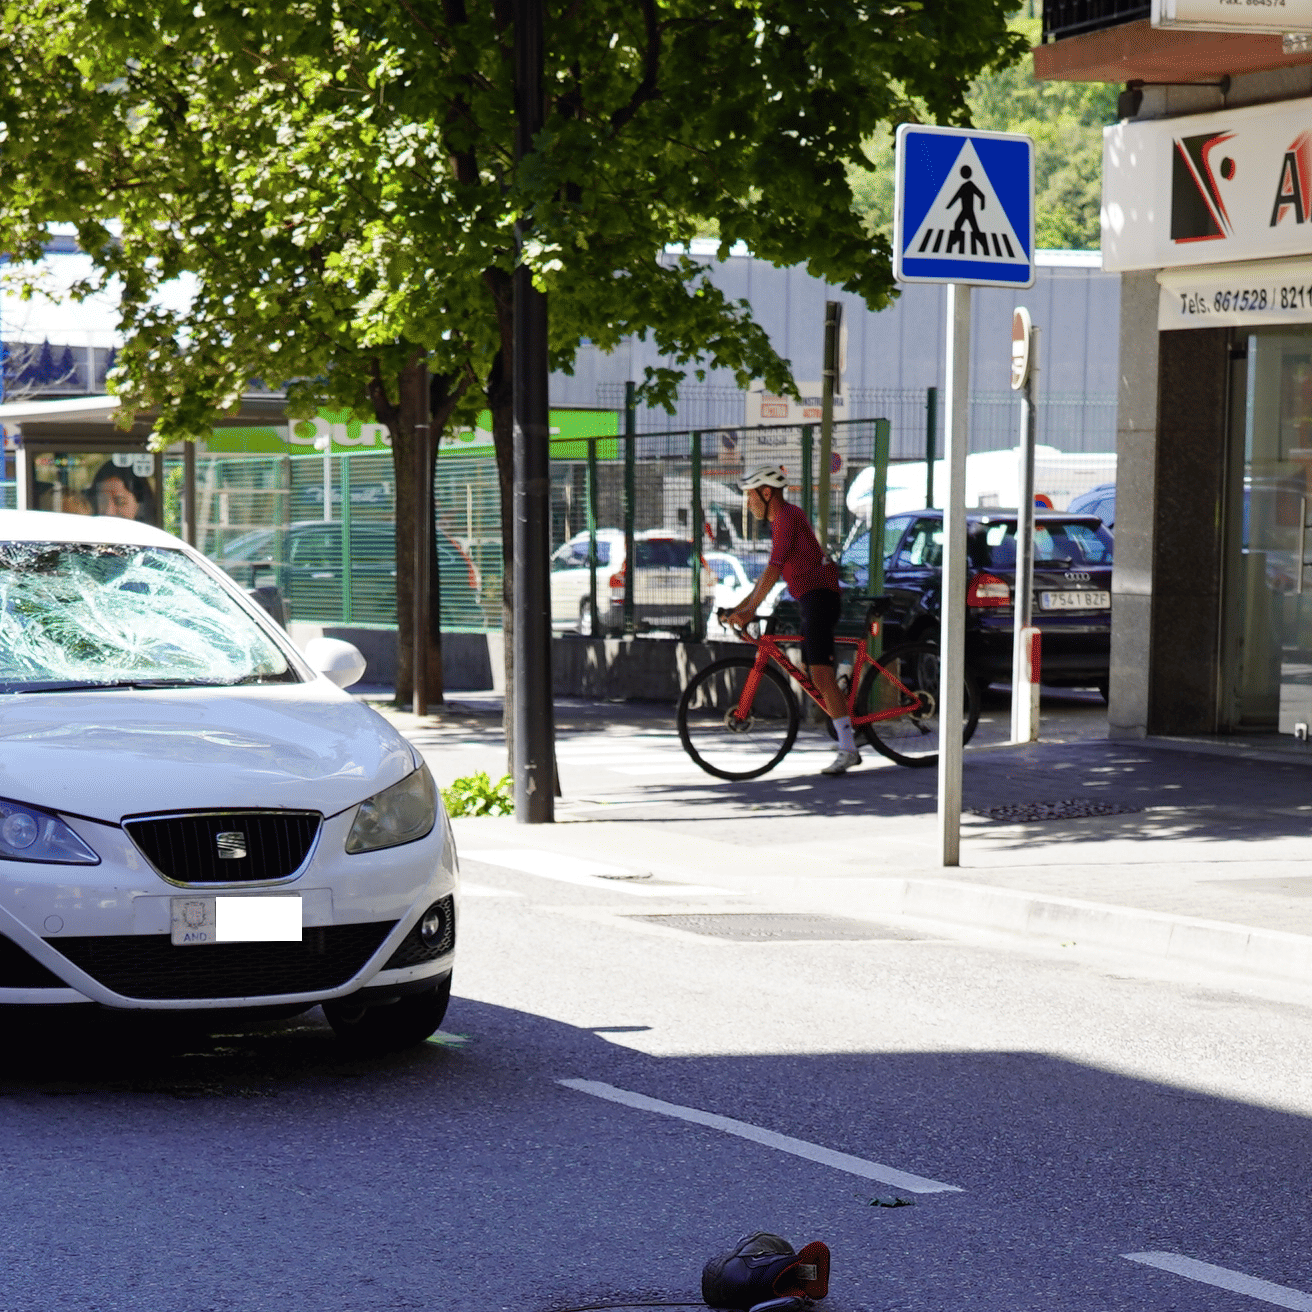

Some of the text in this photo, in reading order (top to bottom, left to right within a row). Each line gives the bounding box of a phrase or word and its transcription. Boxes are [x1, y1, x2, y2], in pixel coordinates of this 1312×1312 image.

[1180, 292, 1211, 315] Tels.
[1213, 288, 1267, 312] 861528
[183, 932, 208, 942] AND
